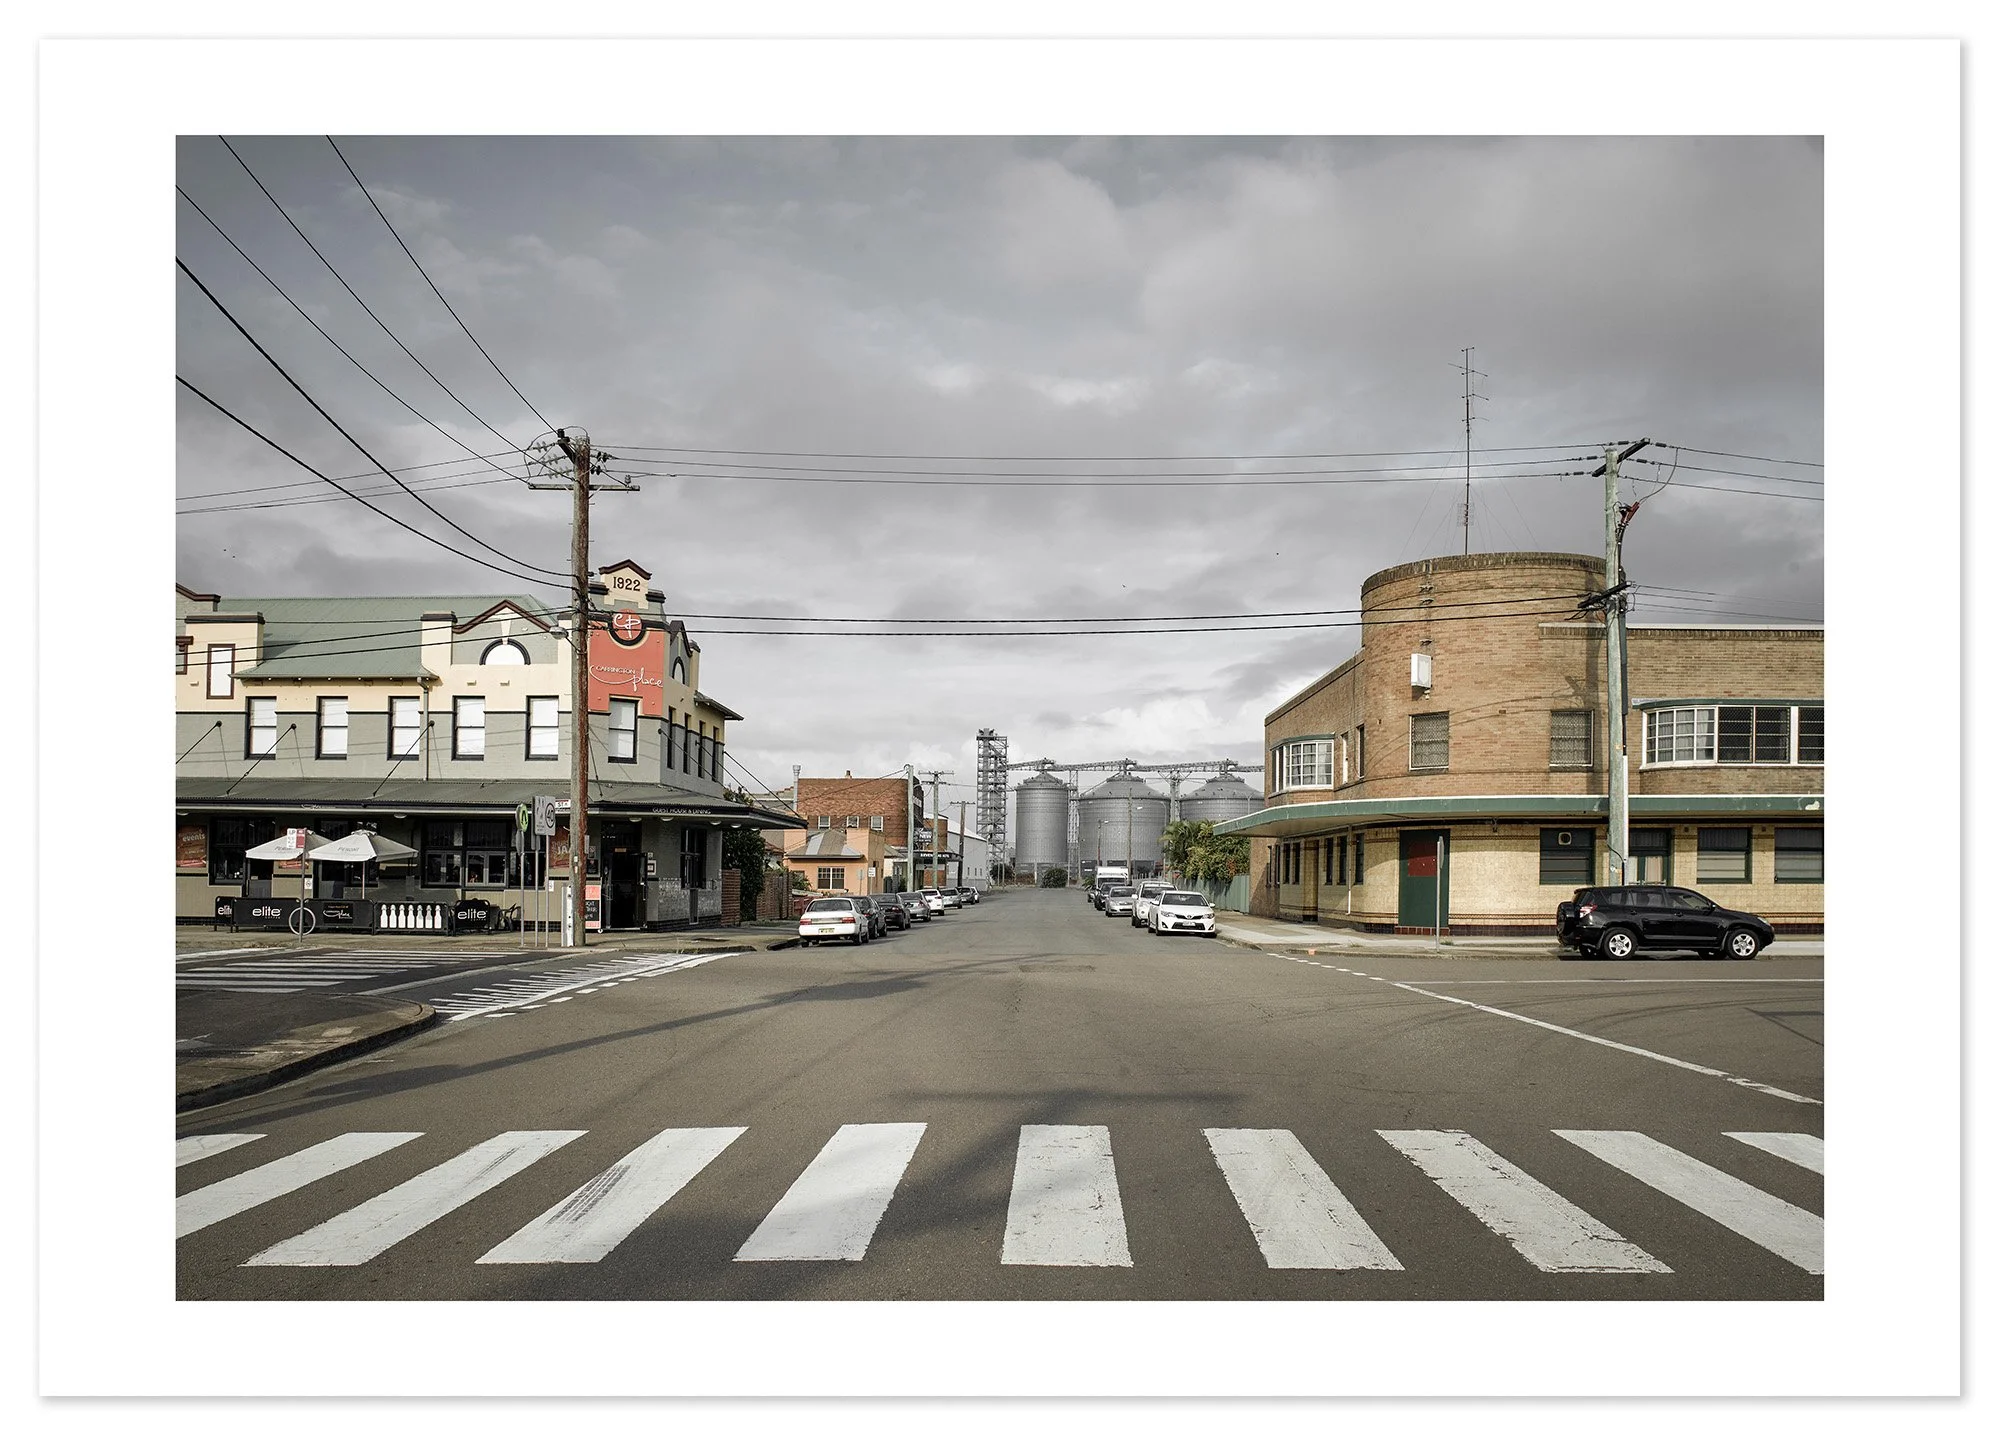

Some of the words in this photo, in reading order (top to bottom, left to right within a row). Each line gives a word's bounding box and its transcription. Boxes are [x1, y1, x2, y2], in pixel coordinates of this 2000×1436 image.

[613, 577, 641, 591] 1922
[633, 667, 663, 691] place
[182, 831, 206, 842] events
[252, 905, 282, 917] elite
[457, 908, 487, 920] elite
